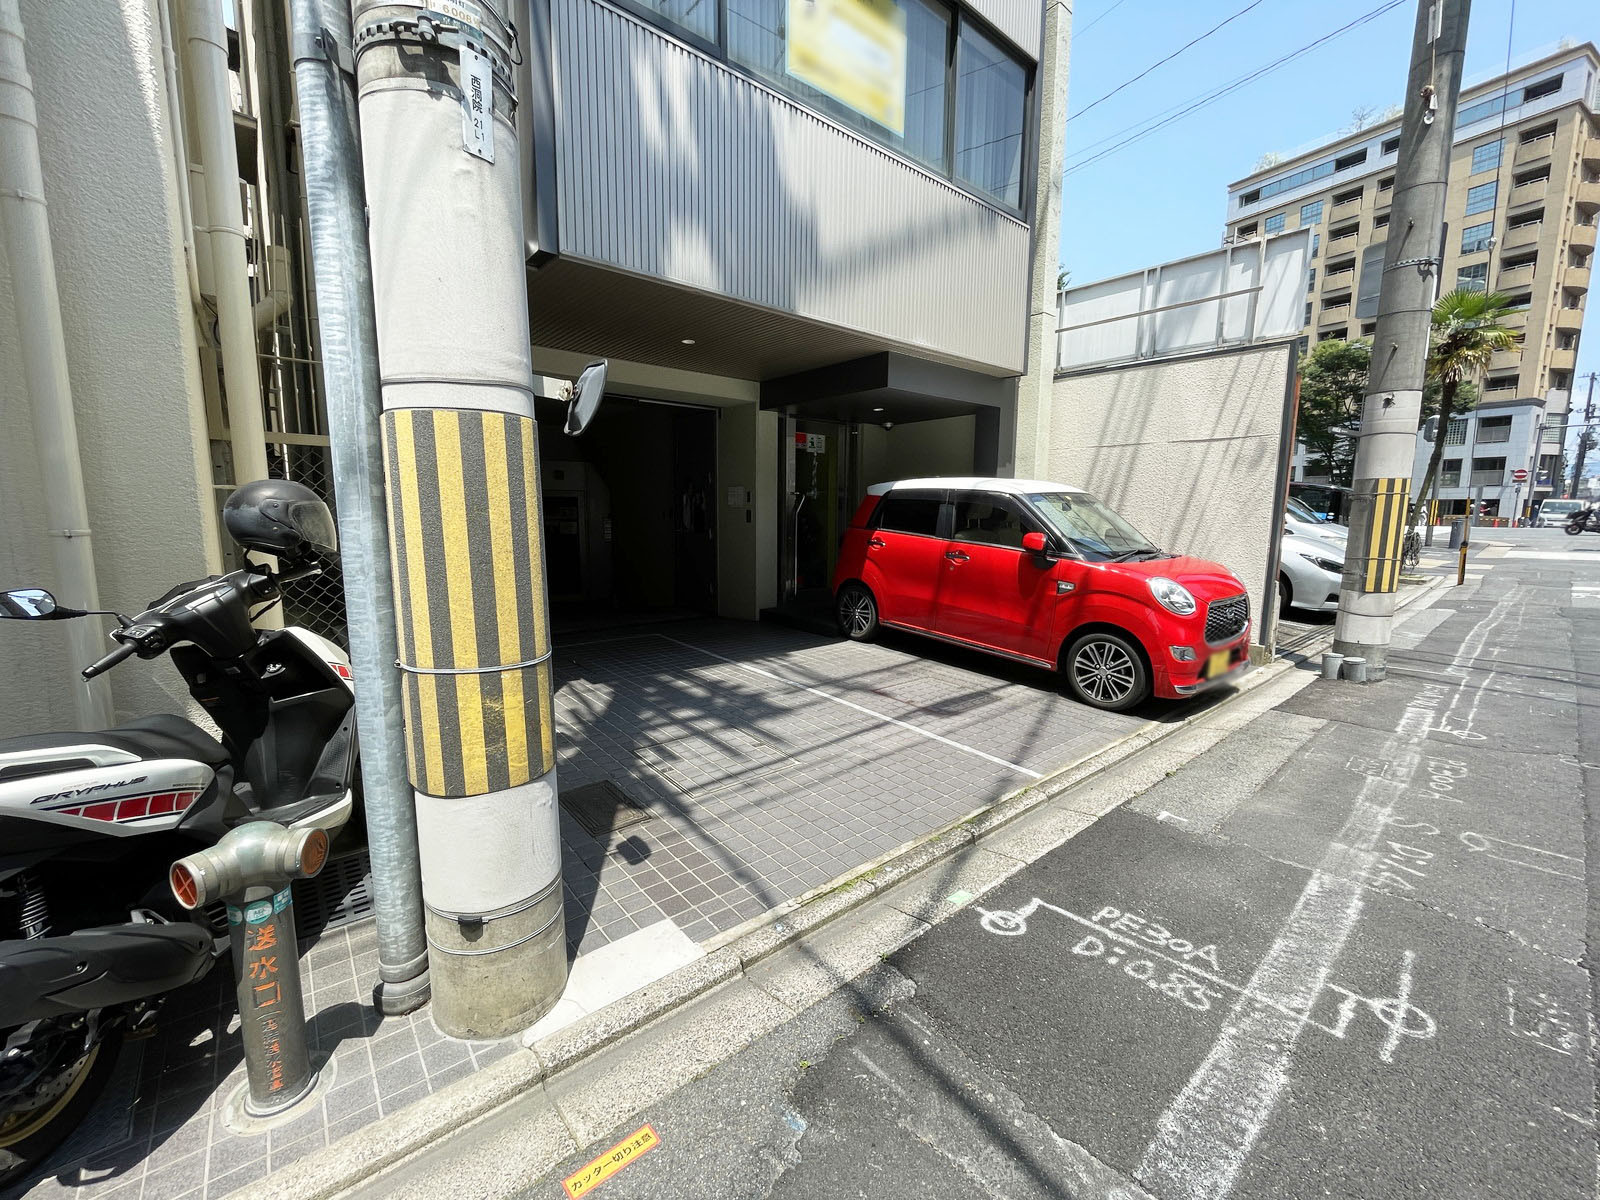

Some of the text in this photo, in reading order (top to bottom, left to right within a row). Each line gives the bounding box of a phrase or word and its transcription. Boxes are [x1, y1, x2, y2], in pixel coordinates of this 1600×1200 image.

[470, 74, 483, 113] 西洞院
[473, 117, 483, 129] 21
[247, 924, 281, 1010] 送水口
[571, 1132, 653, 1192] カッター切り注意
